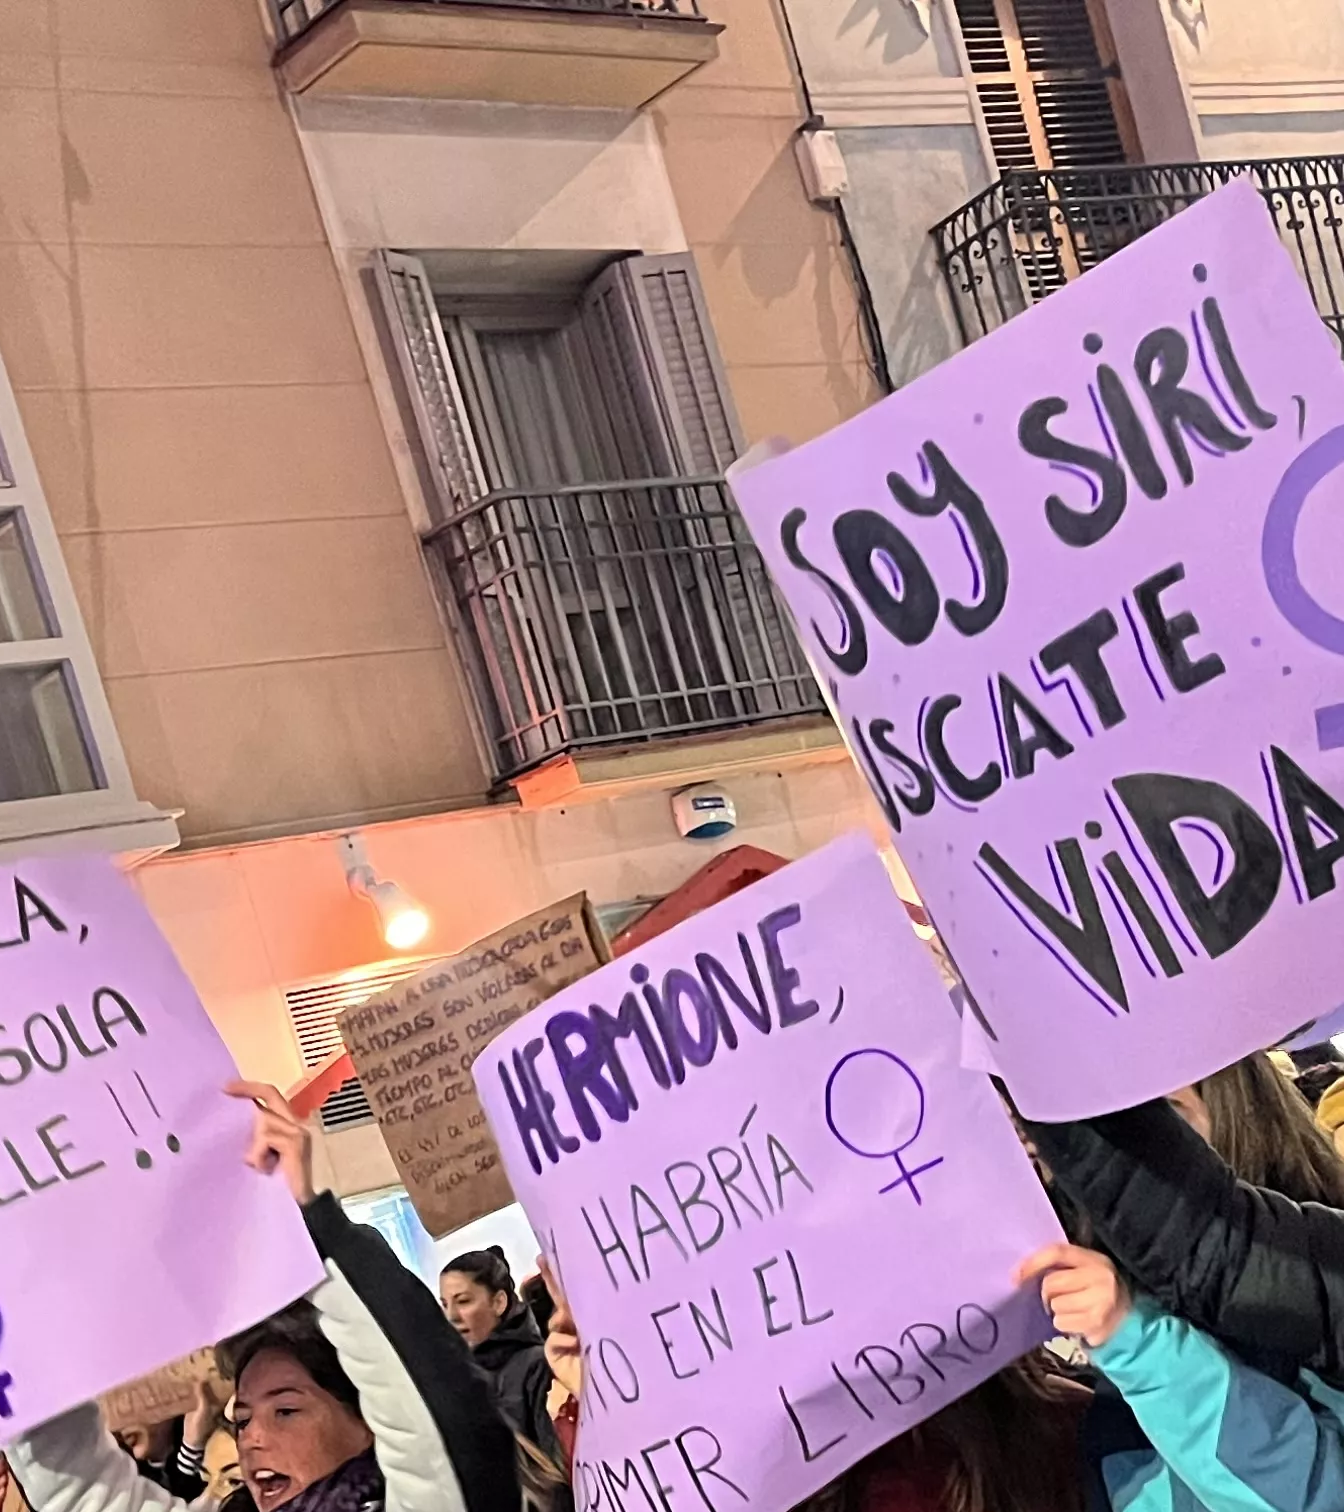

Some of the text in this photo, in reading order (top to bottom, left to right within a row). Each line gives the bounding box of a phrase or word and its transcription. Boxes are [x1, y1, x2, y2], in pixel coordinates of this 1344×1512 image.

[782, 439, 1008, 674] SOY
[497, 903, 844, 1176] HERMIONE,
[581, 1104, 815, 1294] HABRÍA
[652, 1287, 733, 1380] EN
[754, 1250, 834, 1338] EL
[778, 1301, 1000, 1463] LIBRO
